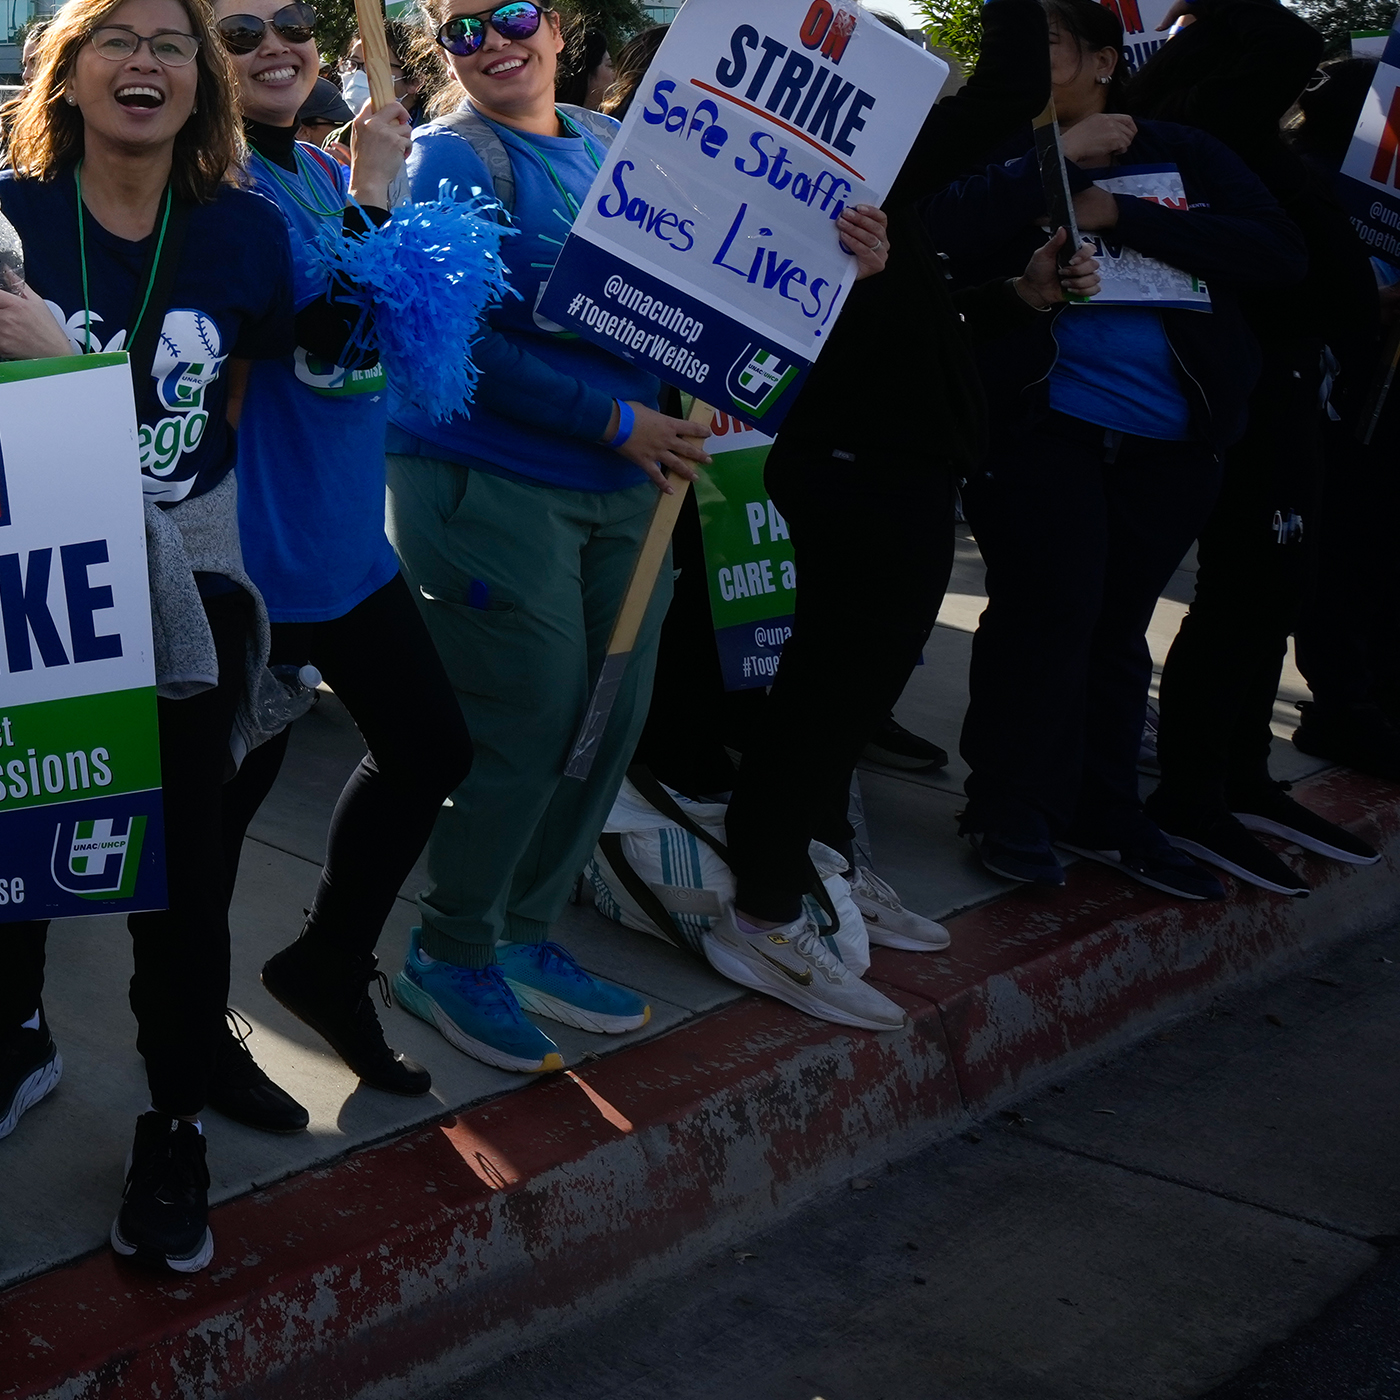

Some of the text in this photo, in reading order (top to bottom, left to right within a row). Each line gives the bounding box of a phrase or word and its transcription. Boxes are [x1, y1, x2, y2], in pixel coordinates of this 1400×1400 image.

[715, 22, 877, 157] STRIKE
[642, 78, 856, 255] Safe Staffi
[597, 160, 842, 338] Saves Lives!
[566, 292, 711, 385] #TogetherWeRise
[602, 273, 705, 344] @unacuhcp
[139, 412, 209, 471] ego
[718, 559, 777, 602] CARE
[72, 839, 127, 853] UNAC/UHCP
